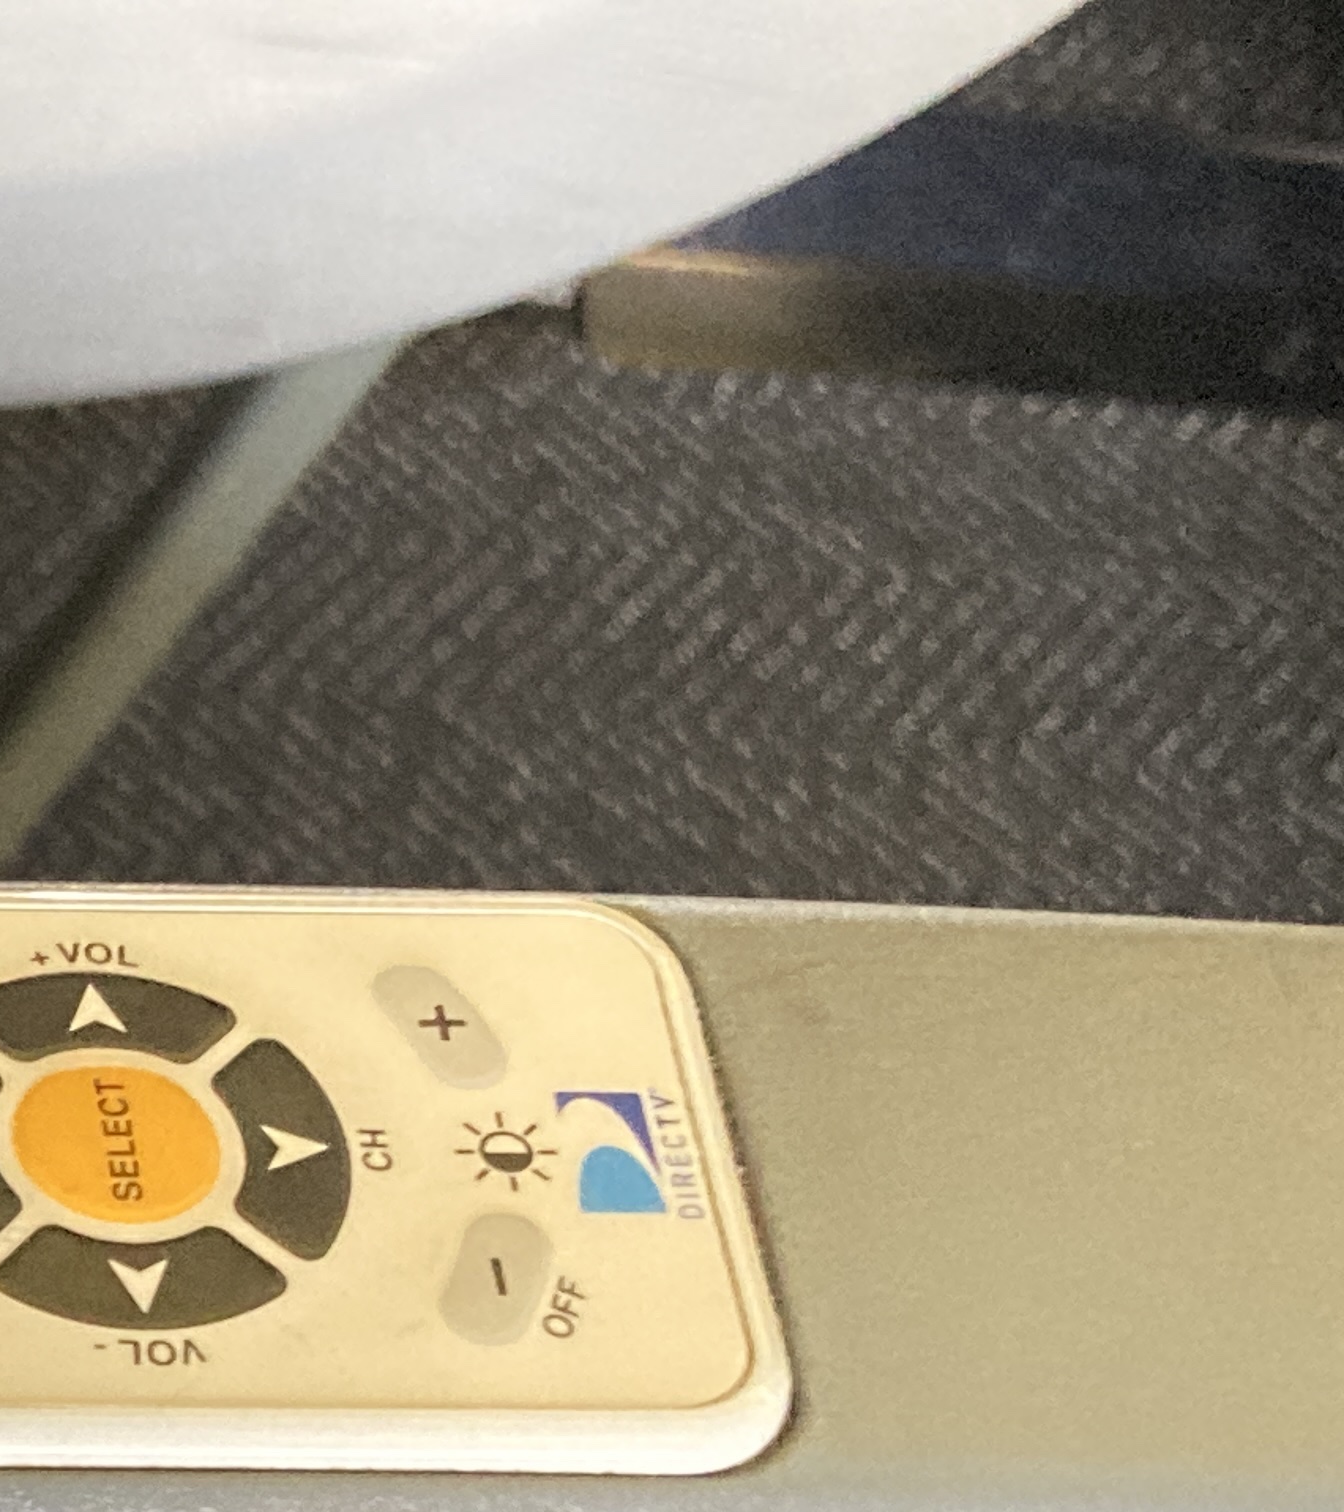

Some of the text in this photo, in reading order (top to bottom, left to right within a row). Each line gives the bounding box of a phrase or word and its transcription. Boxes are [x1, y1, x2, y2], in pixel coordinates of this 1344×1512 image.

[93, 1077, 143, 1202] SELECT
[356, 1128, 393, 1173] CH
[648, 1094, 706, 1220] DIRECTV
[541, 1275, 588, 1340] OFF
